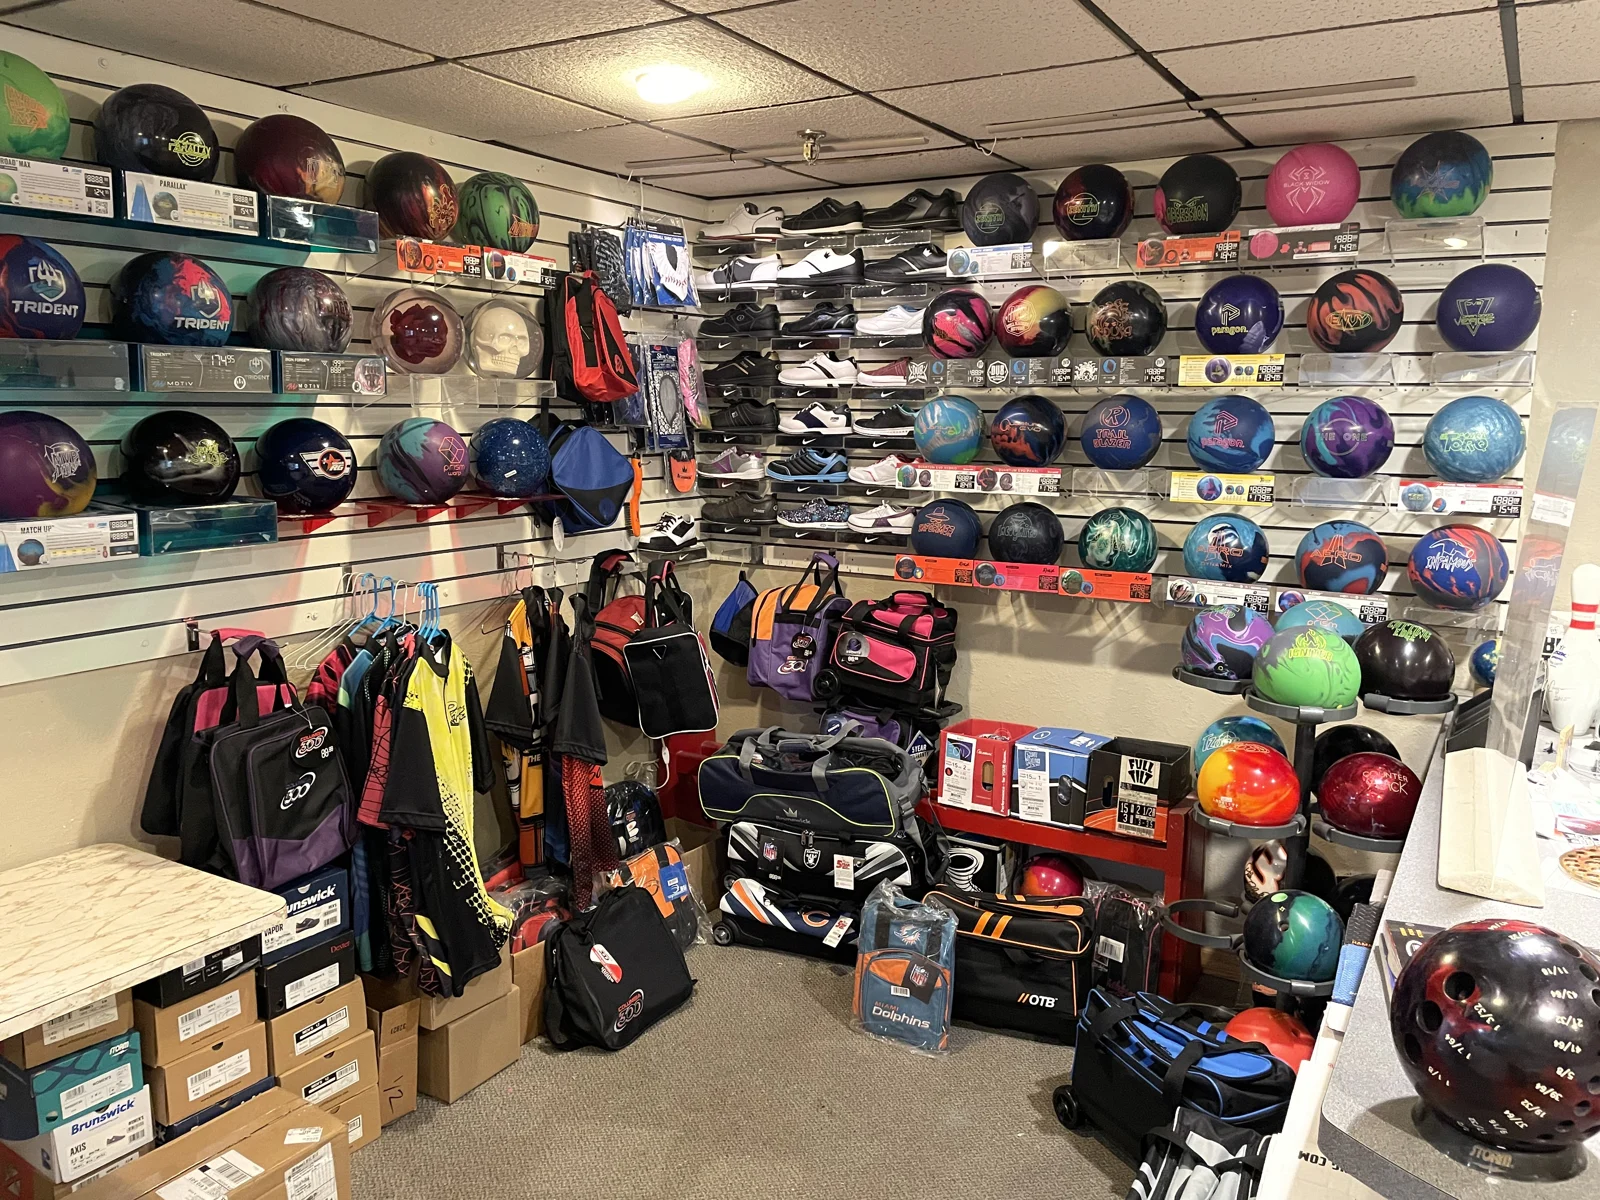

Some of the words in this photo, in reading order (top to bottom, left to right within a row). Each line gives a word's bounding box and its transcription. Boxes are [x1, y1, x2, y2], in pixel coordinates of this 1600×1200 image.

[18, 160, 31, 169] MAX
[159, 180, 186, 190] PARALLAX
[1283, 180, 1305, 188] BLACK
[1305, 179, 1330, 187] WIDOW
[12, 300, 78, 318] TRIDENT
[174, 316, 230, 332] TRIDENT
[1331, 309, 1369, 330] ENVY
[991, 365, 1004, 376] DUB
[1096, 429, 1129, 439] TRAIL
[1342, 432, 1368, 442] ONE
[1093, 438, 1132, 449] BLAZER
[443, 464, 465, 472] prism
[20, 526, 42, 535] MATCH
[1197, 546, 1244, 557] AERO
[1310, 549, 1362, 563] AERO
[1201, 561, 1233, 569] DYNAMIX
[1425, 551, 1474, 572] INFAMOUS
[298, 734, 325, 754] 300
[1129, 759, 1154, 774] FULL
[1128, 769, 1153, 785] TILT
[285, 782, 311, 804] 300
[1120, 803, 1128, 814] 15
[1136, 806, 1141, 815] 2
[1143, 807, 1153, 817] 1/2
[1122, 814, 1128, 823] 3
[264, 923, 284, 937] VAPOR
[330, 941, 351, 954] Dexter
[617, 993, 642, 1013] COLUMBIA
[874, 1001, 899, 1012] MIAMI
[616, 998, 643, 1027] 300
[872, 1005, 931, 1029] Dolphins
[1473, 1002, 1496, 1026] 3/32
[109, 1040, 130, 1052] STORM
[1444, 1032, 1465, 1054] 7/64
[1553, 1039, 1583, 1055] 41/64
[93, 1074, 112, 1086] WOMEN'S
[1556, 1065, 1576, 1081] 5/8
[1534, 1081, 1564, 1103] 39/64
[1520, 1097, 1547, 1118] 19/32
[71, 1098, 135, 1136] Brunswick
[1503, 1108, 1529, 1130] 37/64
[70, 1142, 87, 1157] AXIS
[1471, 1145, 1513, 1167] STORM
